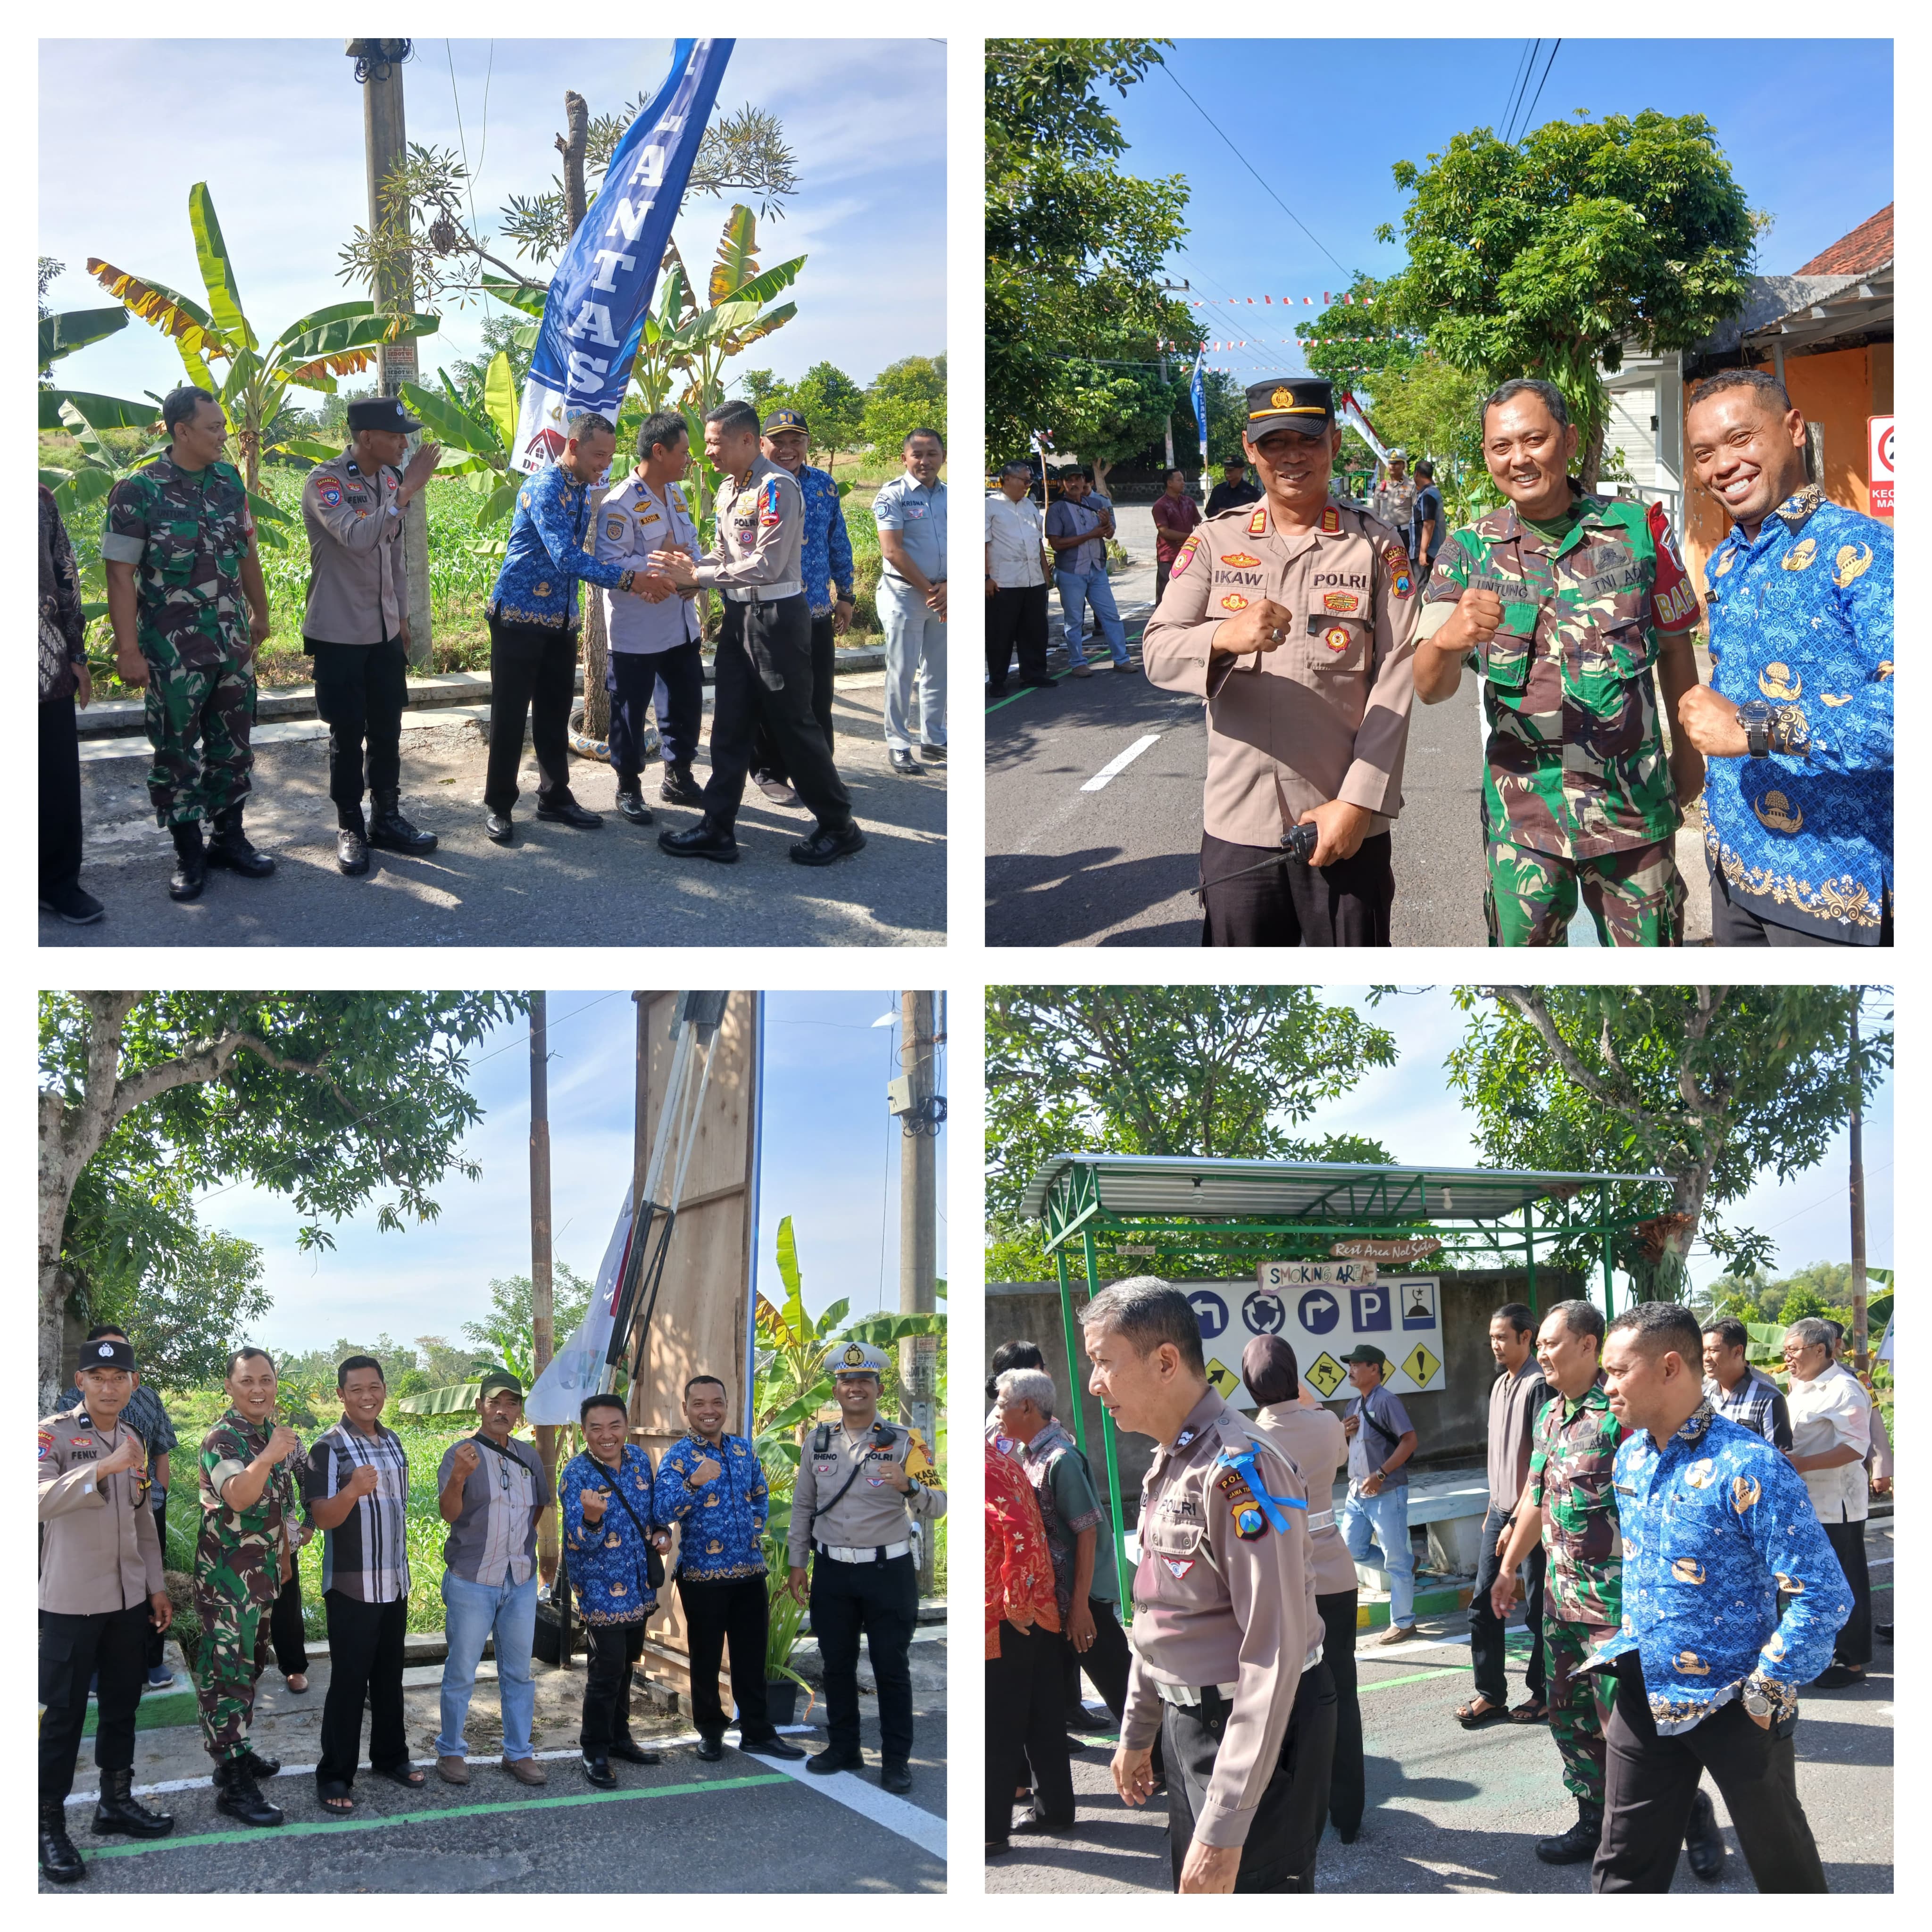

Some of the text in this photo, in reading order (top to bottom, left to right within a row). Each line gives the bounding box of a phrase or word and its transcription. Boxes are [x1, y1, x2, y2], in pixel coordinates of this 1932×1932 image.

[348, 495, 367, 504] FENLY
[158, 509, 192, 518] UNTUNG
[643, 514, 658, 524] RONI
[1215, 570, 1263, 586] IKAW
[1314, 573, 1367, 588] POLRI
[1591, 567, 1641, 591] TNI AD
[1477, 580, 1528, 598] UNTUNG
[1654, 577, 1697, 624] BAB
[1335, 1241, 1436, 1259] Rest Area Nol Satu
[1270, 1264, 1374, 1285] SMOKING AREA
[1361, 1293, 1382, 1327] P
[1573, 1441, 1584, 1451] TNI
[71, 1450, 97, 1460] FENLY
[1222, 1473, 1242, 1489] POL
[1229, 1489, 1242, 1499] JAWA
[1159, 1499, 1196, 1516] POLRI
